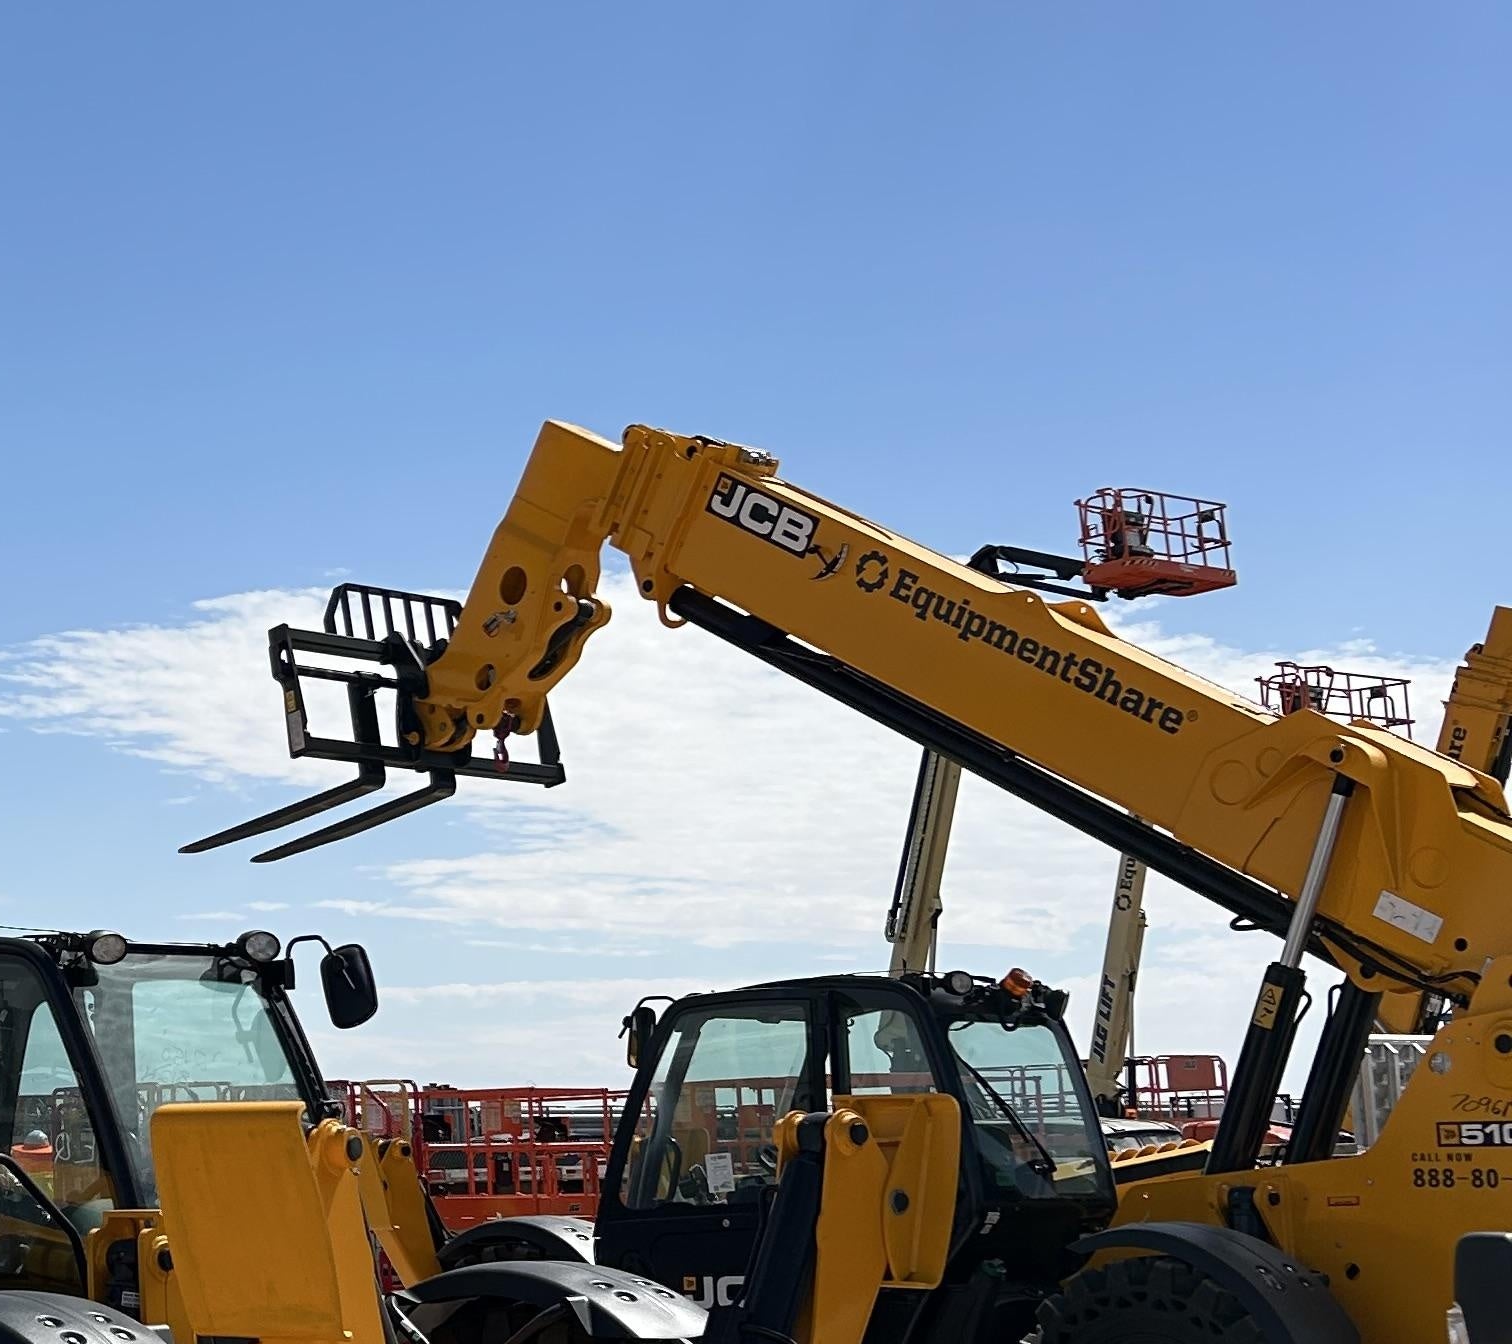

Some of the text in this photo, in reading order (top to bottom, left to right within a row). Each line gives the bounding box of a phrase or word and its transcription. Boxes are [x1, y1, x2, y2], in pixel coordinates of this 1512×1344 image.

[710, 484, 814, 552] JCB
[1411, 1152, 1441, 1162] CALL
[684, 1275, 746, 1310] JC
